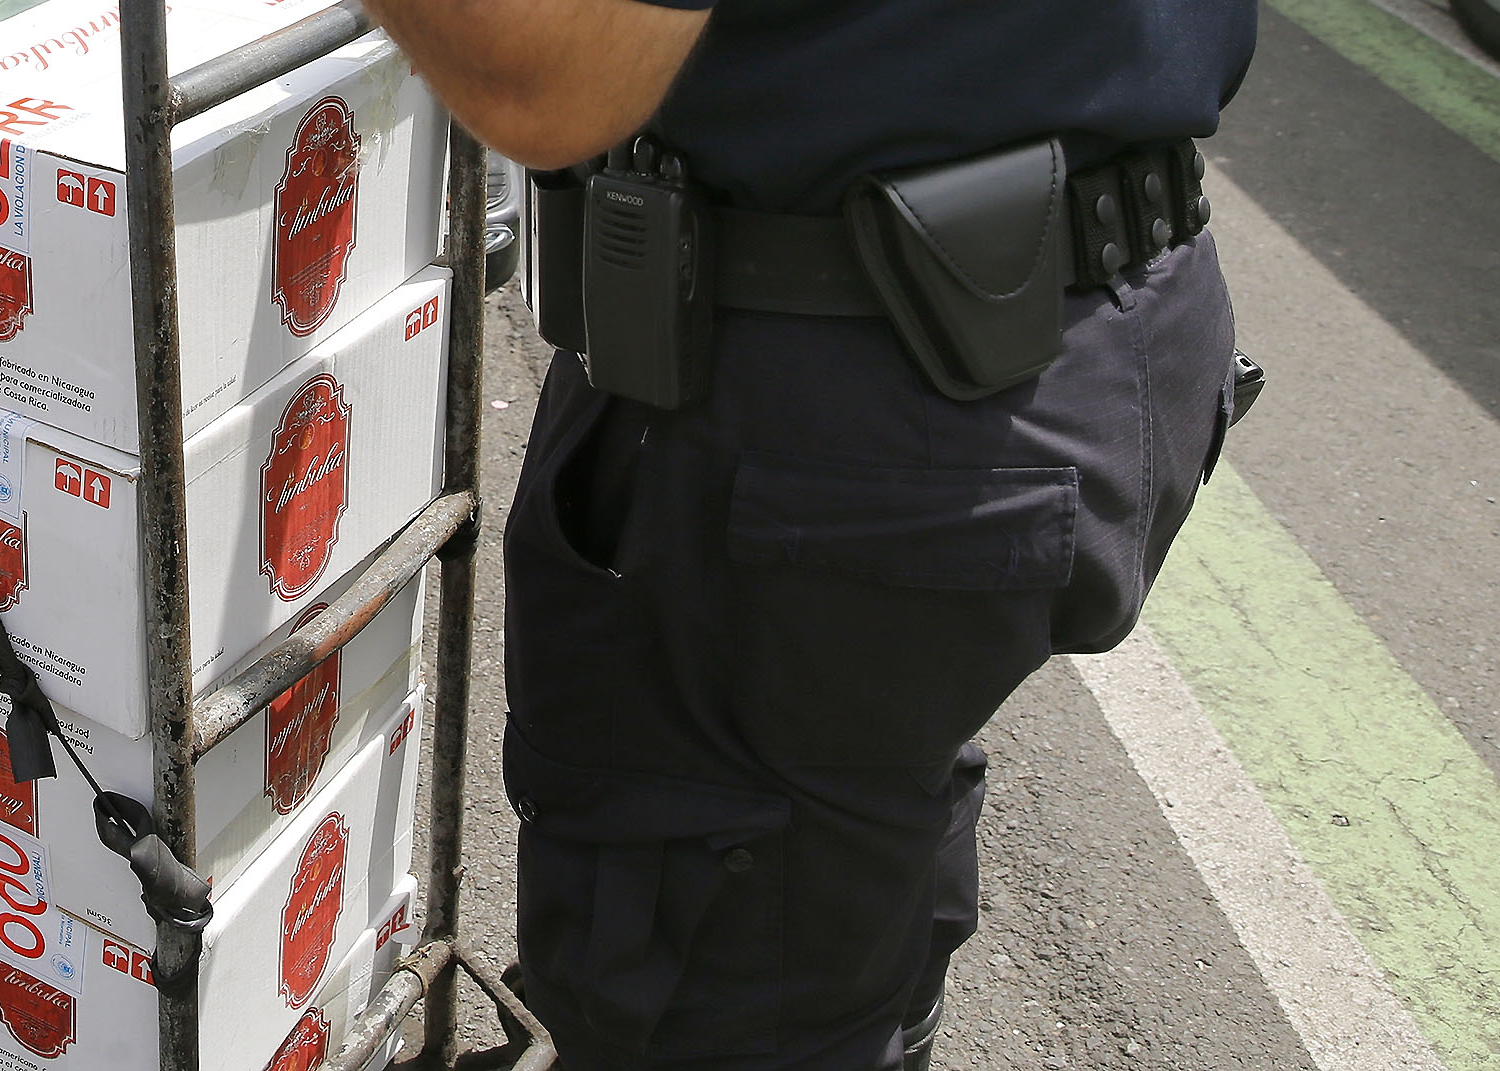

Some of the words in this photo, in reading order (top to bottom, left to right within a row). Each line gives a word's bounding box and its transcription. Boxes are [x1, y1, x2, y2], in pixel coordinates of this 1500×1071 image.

[14, 157, 25, 223] VIOLACION
[606, 191, 644, 206] KENWOOD
[14, 225, 23, 237] LA
[0, 372, 18, 386] para
[19, 380, 91, 412] comercializadora
[3, 386, 27, 404] Costa
[28, 394, 50, 412] Rica.
[38, 372, 50, 383] en
[50, 375, 95, 400] Nicaragua
[32, 643, 43, 654] en
[44, 647, 86, 675] Nicaragua
[75, 725, 90, 739] por
